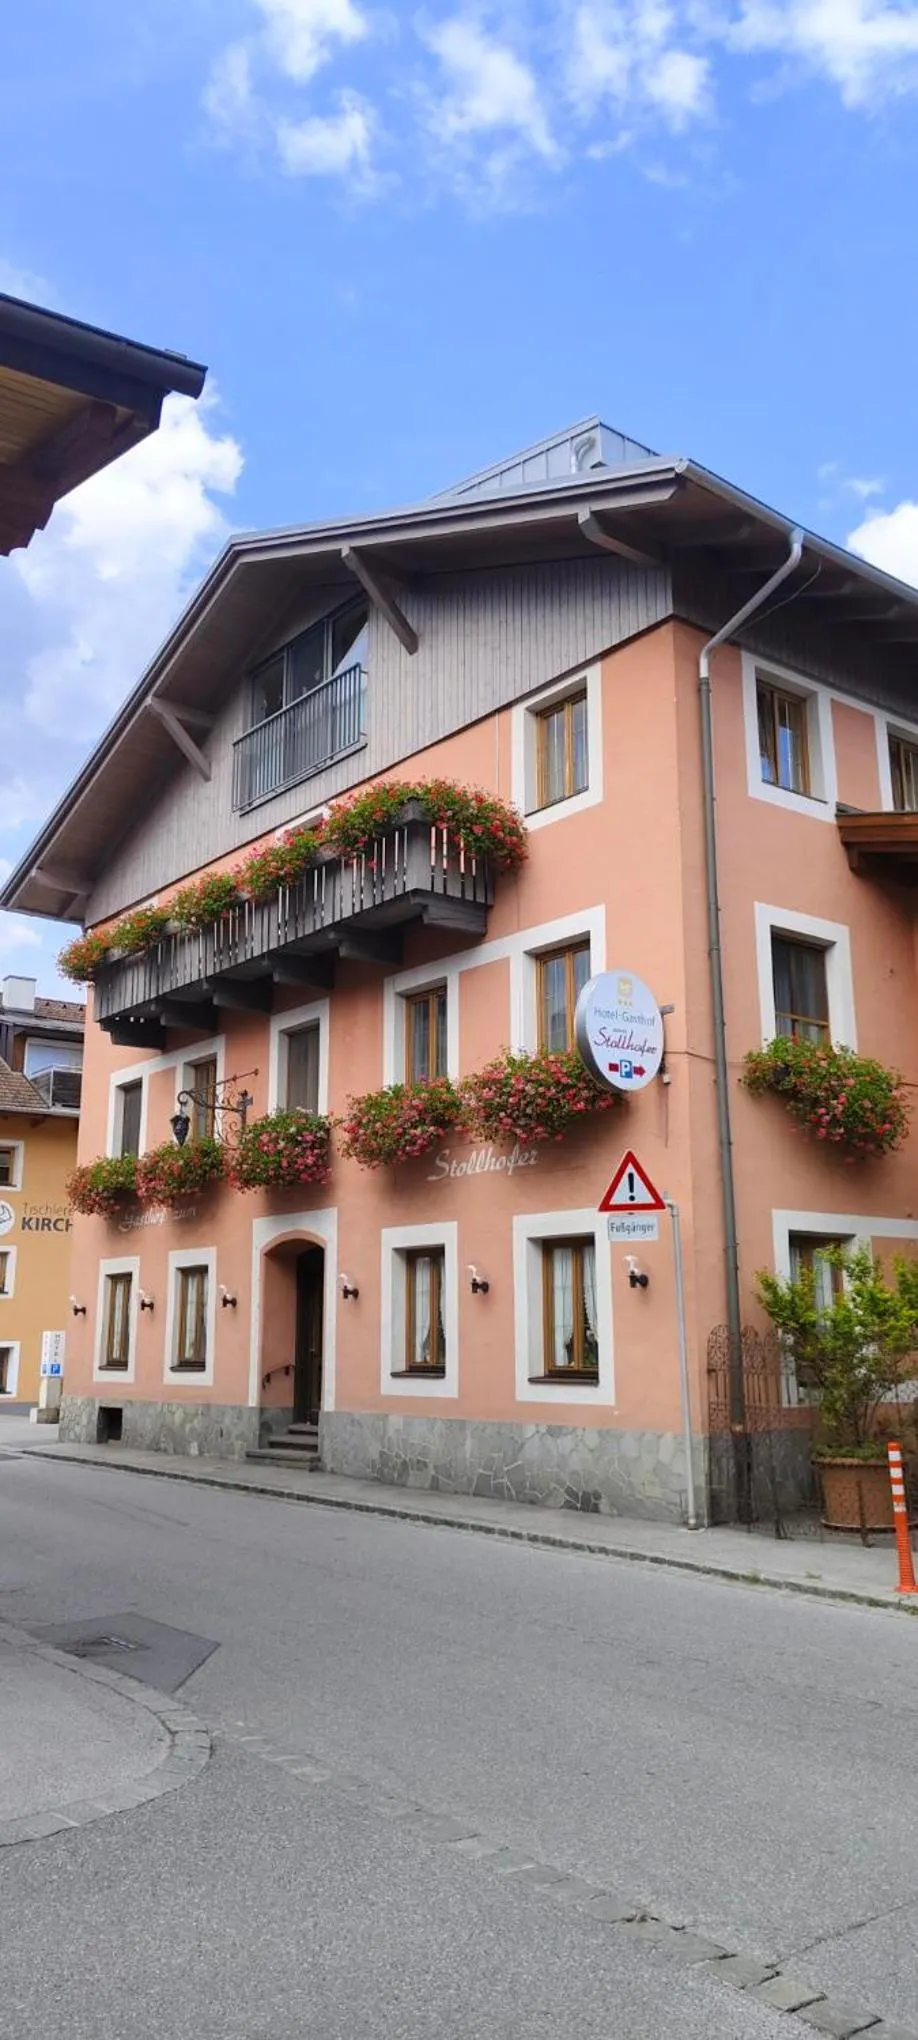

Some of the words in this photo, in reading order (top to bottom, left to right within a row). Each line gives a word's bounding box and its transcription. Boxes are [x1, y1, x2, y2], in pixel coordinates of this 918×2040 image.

[594, 1006, 655, 1026] Hotel-Gasthof
[594, 1026, 657, 1056] Stollhofer
[427, 1144, 538, 1180] Stollhofer
[610, 1222, 655, 1234] Fußgänger
